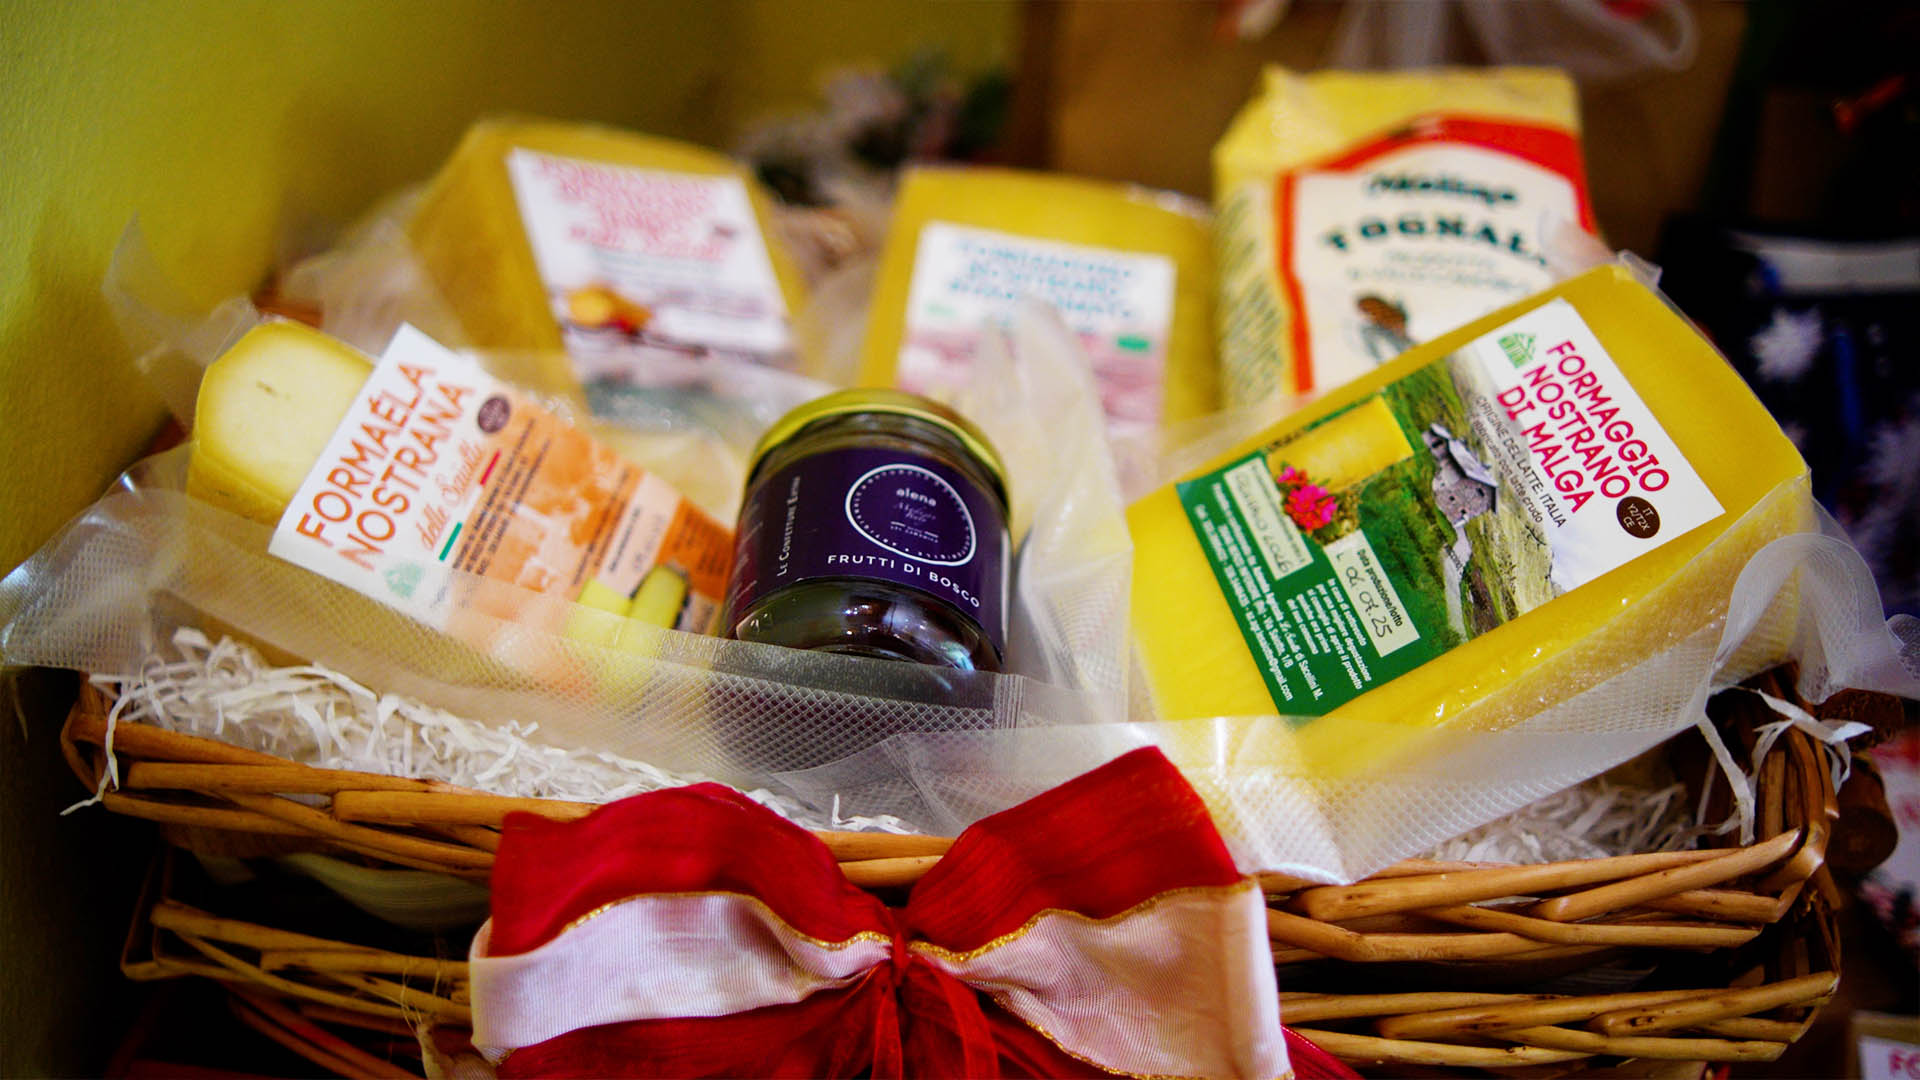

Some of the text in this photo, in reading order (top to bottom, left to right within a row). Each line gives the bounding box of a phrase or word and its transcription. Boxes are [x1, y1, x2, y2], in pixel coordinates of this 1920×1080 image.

[1497, 385, 1594, 513] DI MALGA
[1523, 364, 1630, 498] NOSTRANO
[1547, 340, 1669, 492] FORMAGGIO
[296, 362, 437, 547] FORMAÉLA
[338, 381, 474, 570] NOSTRANA
[1501, 435, 1523, 460] DEL
[1515, 456, 1546, 496] LATTE:
[1539, 493, 1566, 527] ITALIA
[1506, 472, 1529, 499] latte
[1520, 494, 1545, 525] crudo
[1623, 516, 1635, 527] CE
[1627, 503, 1650, 530] Y2/T2X
[1642, 507, 1654, 515] IT
[827, 554, 981, 608] FRUTTI DI BOSCO
[1356, 548, 1370, 567] Data
